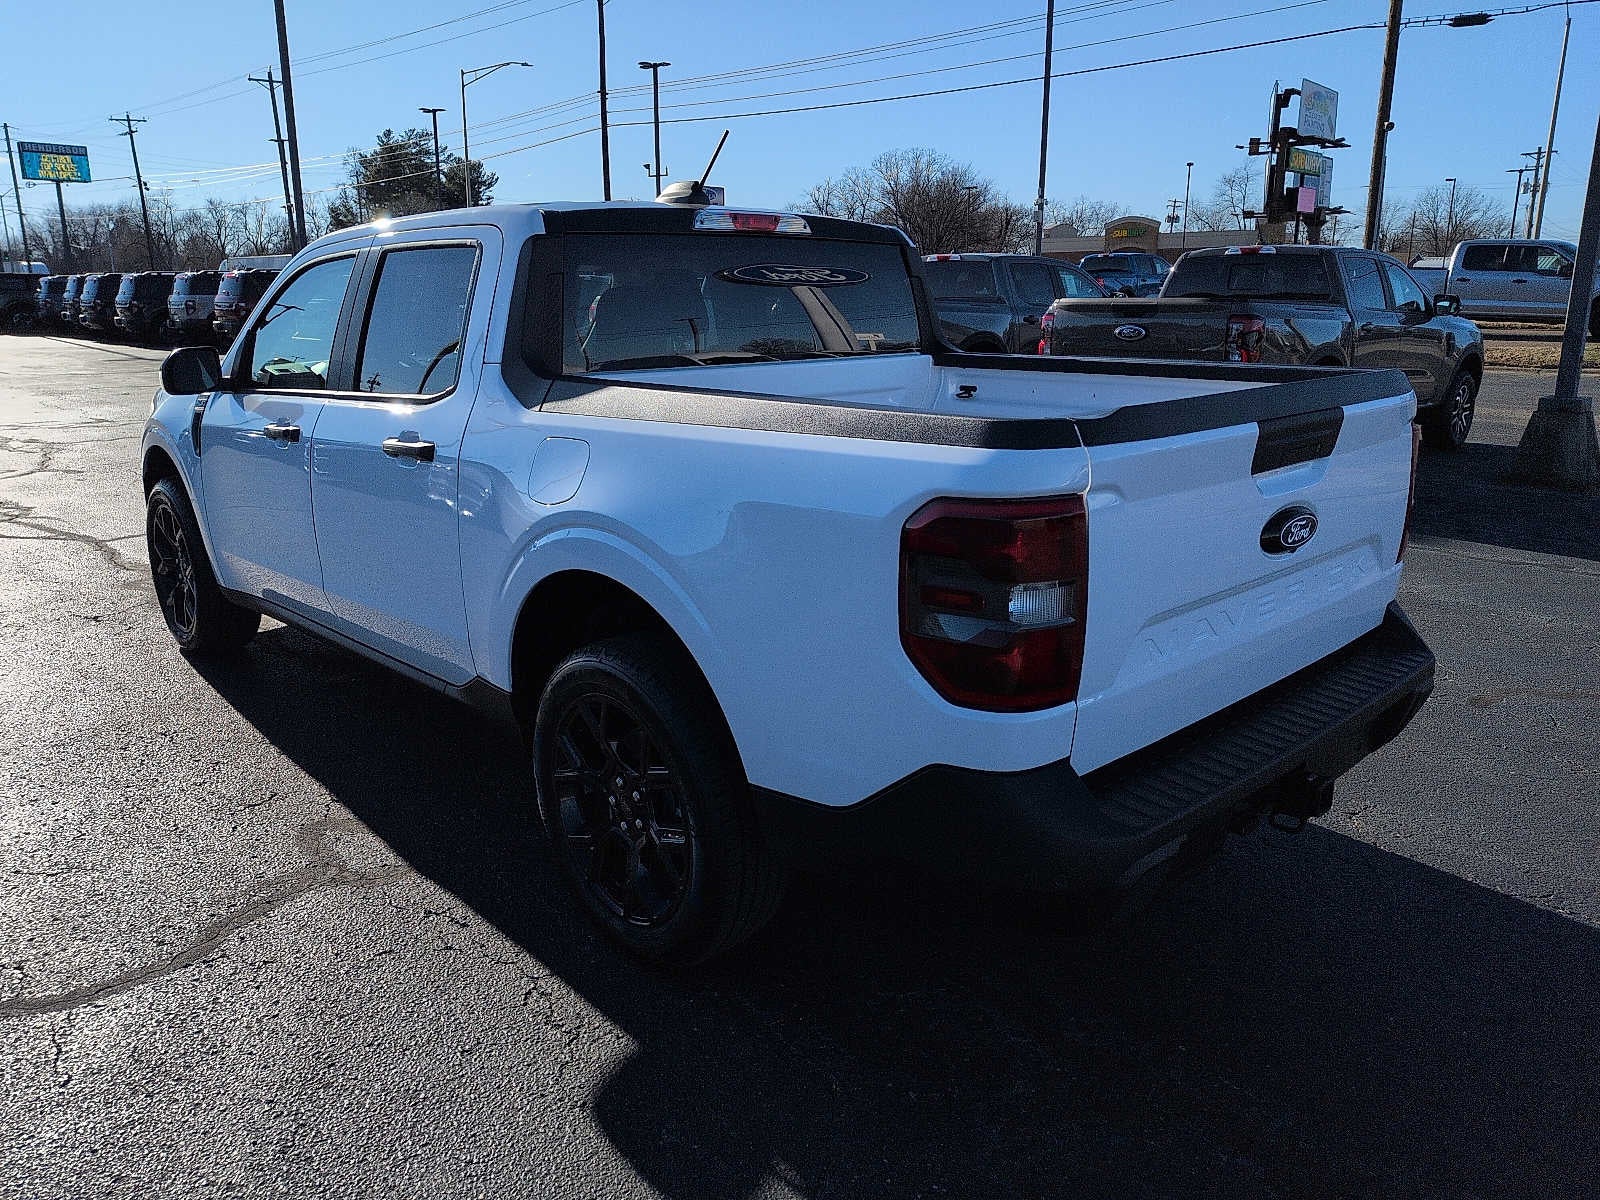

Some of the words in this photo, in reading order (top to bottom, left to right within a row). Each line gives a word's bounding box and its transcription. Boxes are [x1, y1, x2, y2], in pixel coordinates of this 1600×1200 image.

[24, 143, 86, 155] HENDERSON
[1293, 152, 1320, 172] SUBWAY
[1287, 519, 1312, 544] Ford
[1143, 555, 1368, 659] MAVERCK
